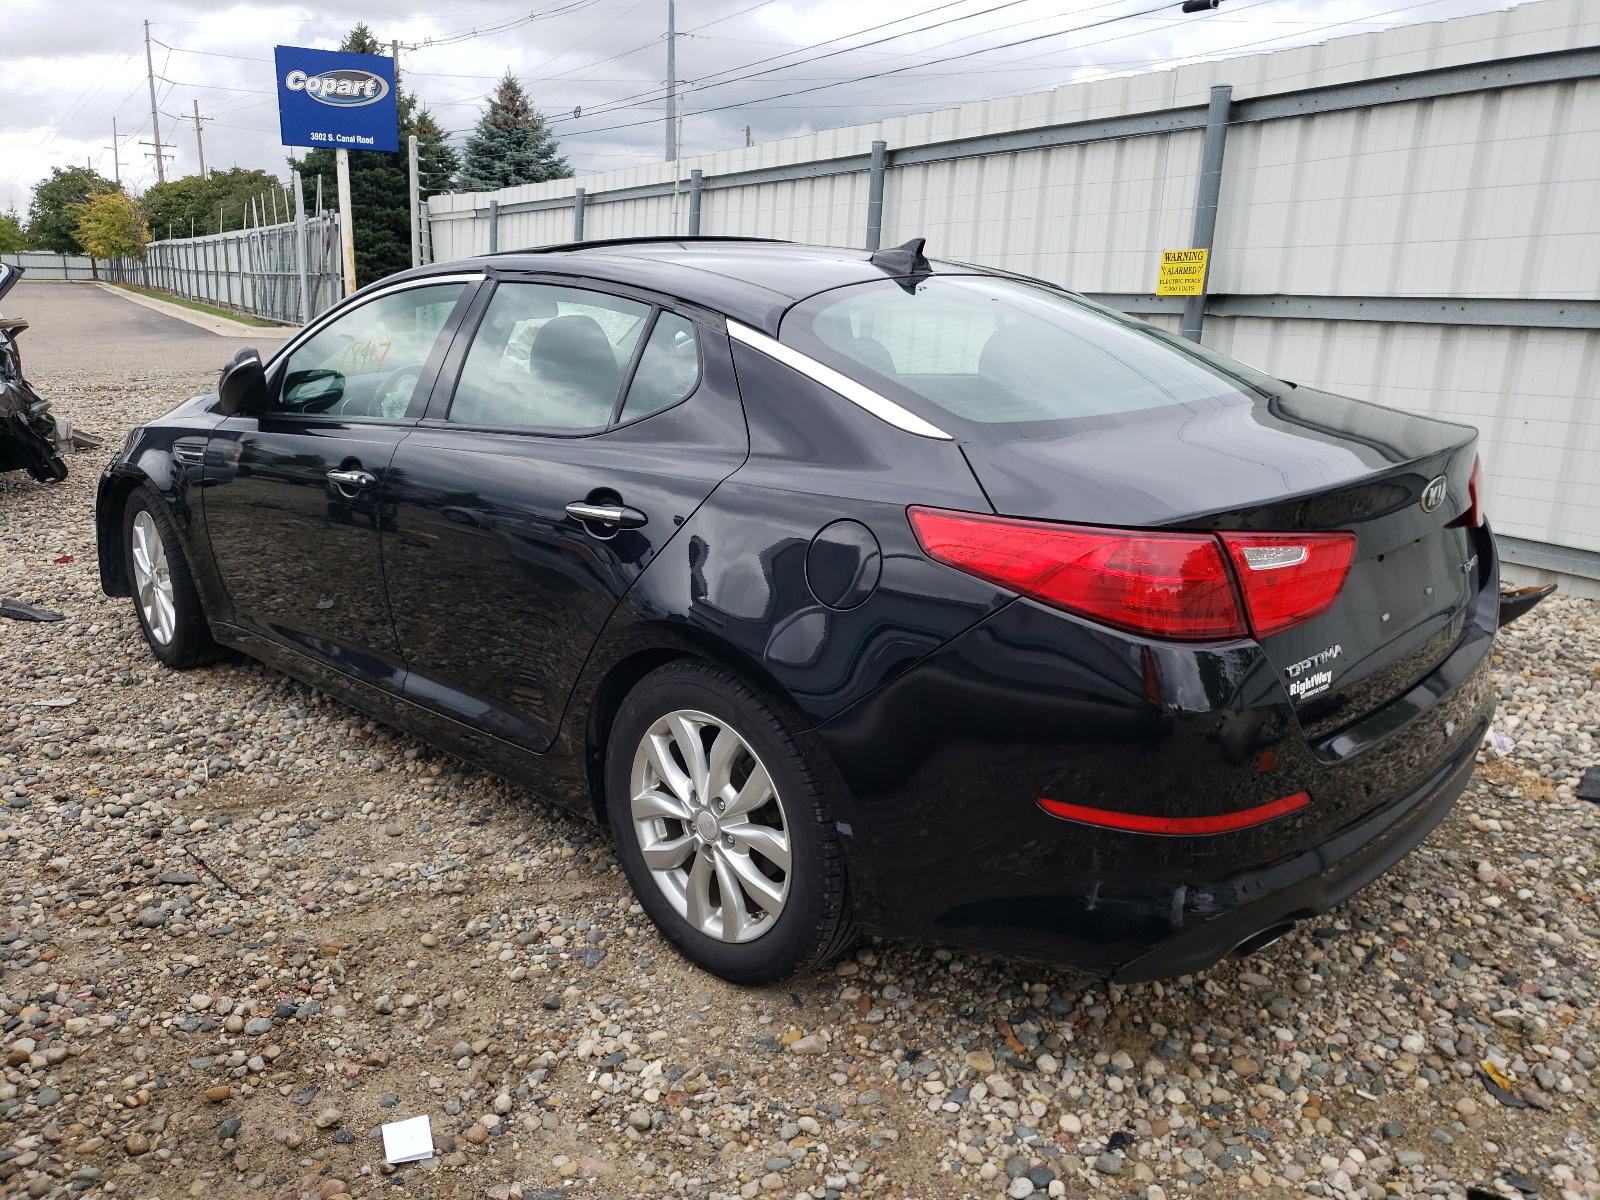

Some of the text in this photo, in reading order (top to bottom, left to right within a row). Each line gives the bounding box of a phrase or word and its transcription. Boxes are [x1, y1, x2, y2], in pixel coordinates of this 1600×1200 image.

[285, 69, 378, 97] Copart
[310, 132, 374, 145] 3902 S. Canal Road
[1165, 251, 1204, 262] WARNING
[1167, 266, 1197, 275] ALARMED
[1286, 644, 1343, 678] OPTIMA
[1290, 670, 1332, 696] RightWay
